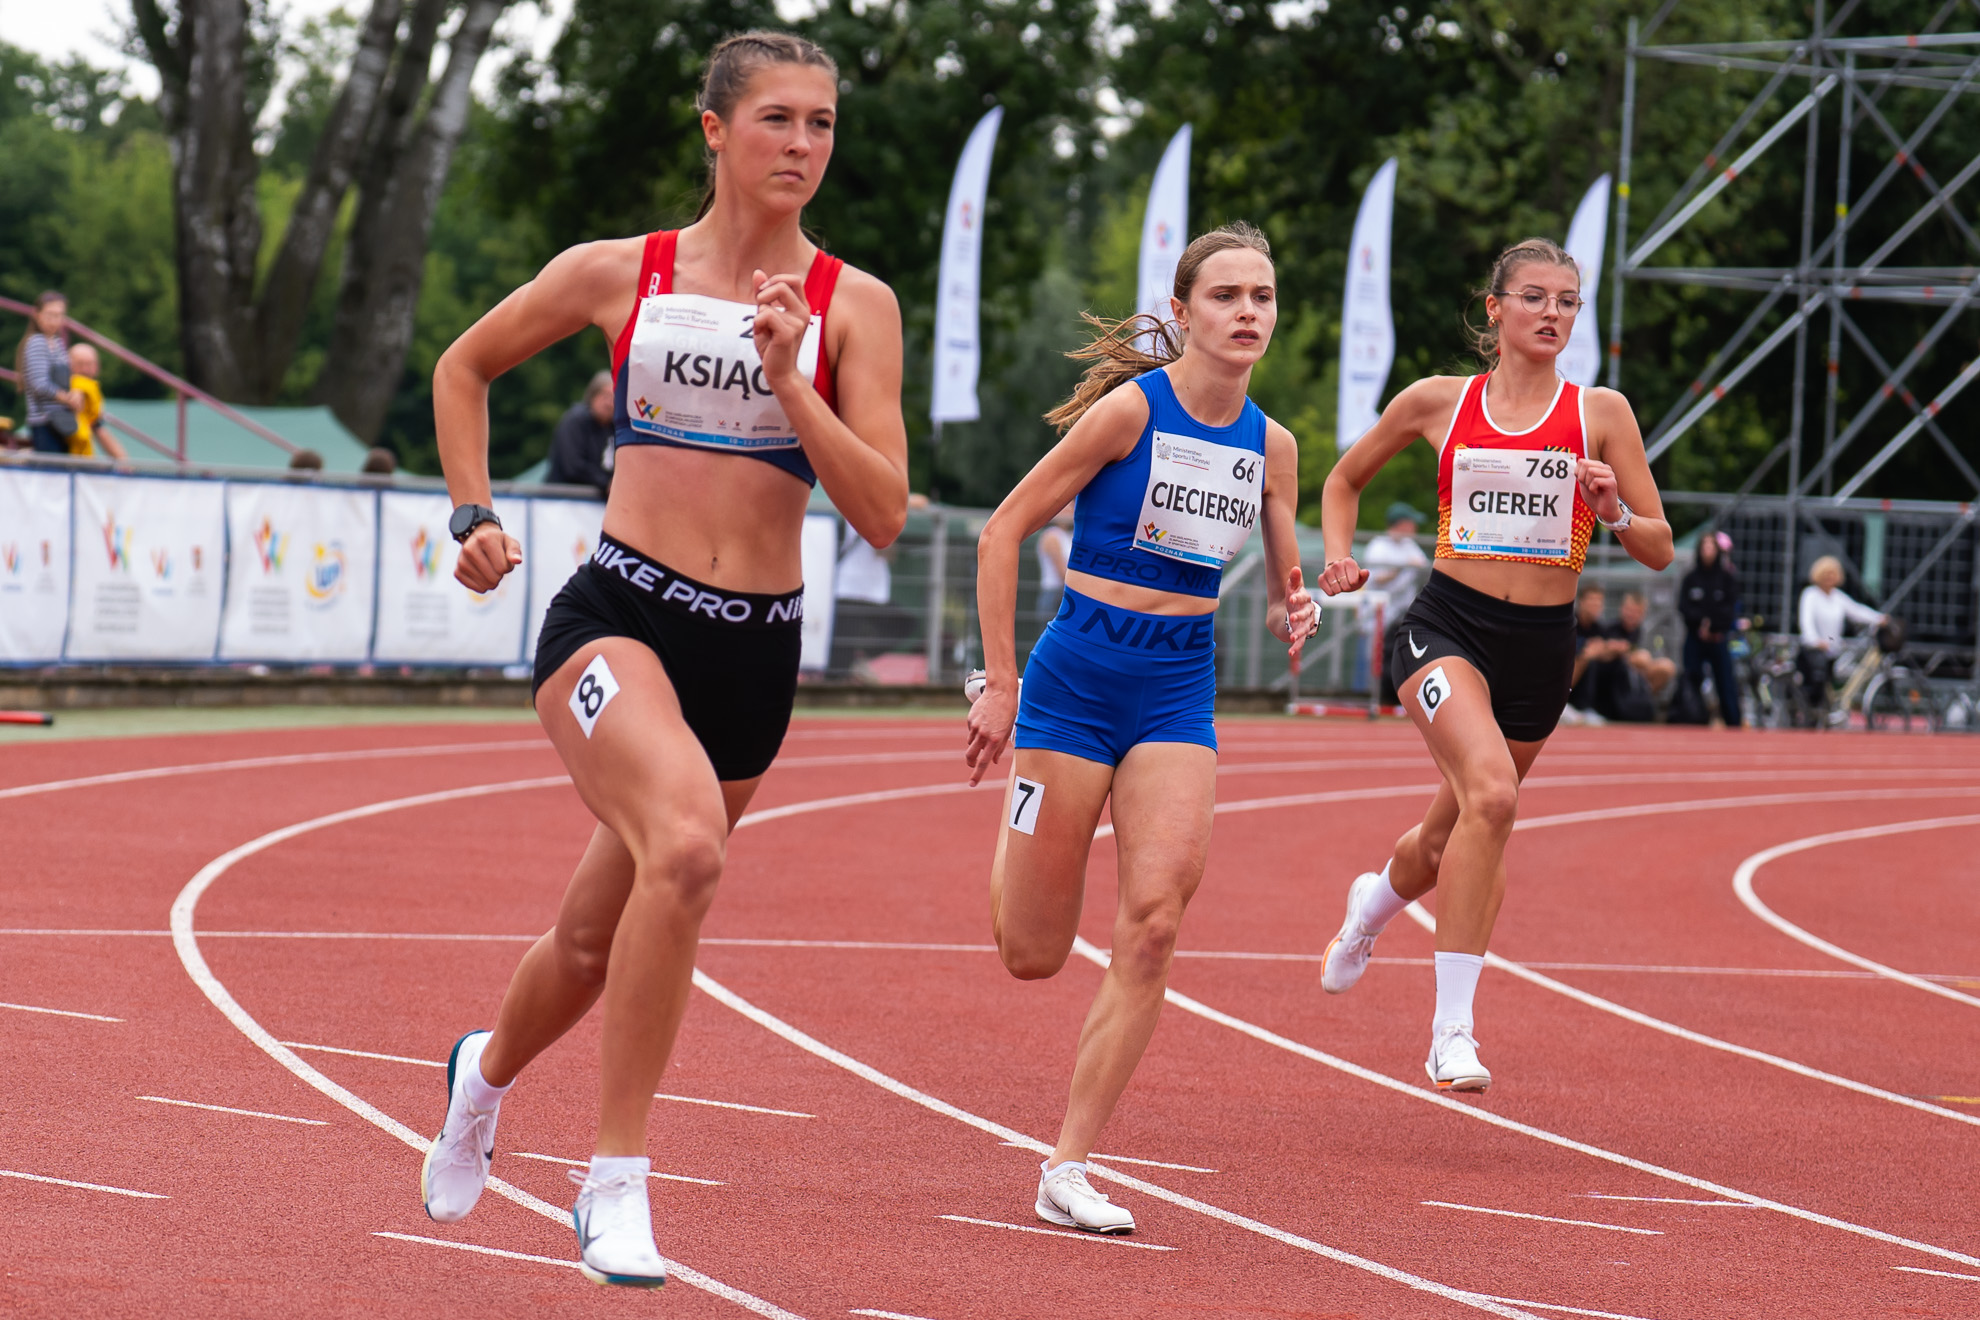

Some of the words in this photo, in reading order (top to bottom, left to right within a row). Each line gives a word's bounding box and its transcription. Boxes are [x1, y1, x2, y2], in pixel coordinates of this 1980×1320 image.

[1232, 457, 1256, 484] 66
[1525, 457, 1569, 480] 768
[1151, 481, 1256, 530] CIECIERSKA
[1468, 490, 1560, 517] GIEREK
[1089, 552, 1162, 581] PRO
[661, 579, 752, 622] PRO
[1078, 607, 1213, 652] NIKE
[578, 674, 604, 718] 8
[1423, 677, 1441, 709] 6
[1014, 781, 1036, 825] 7
